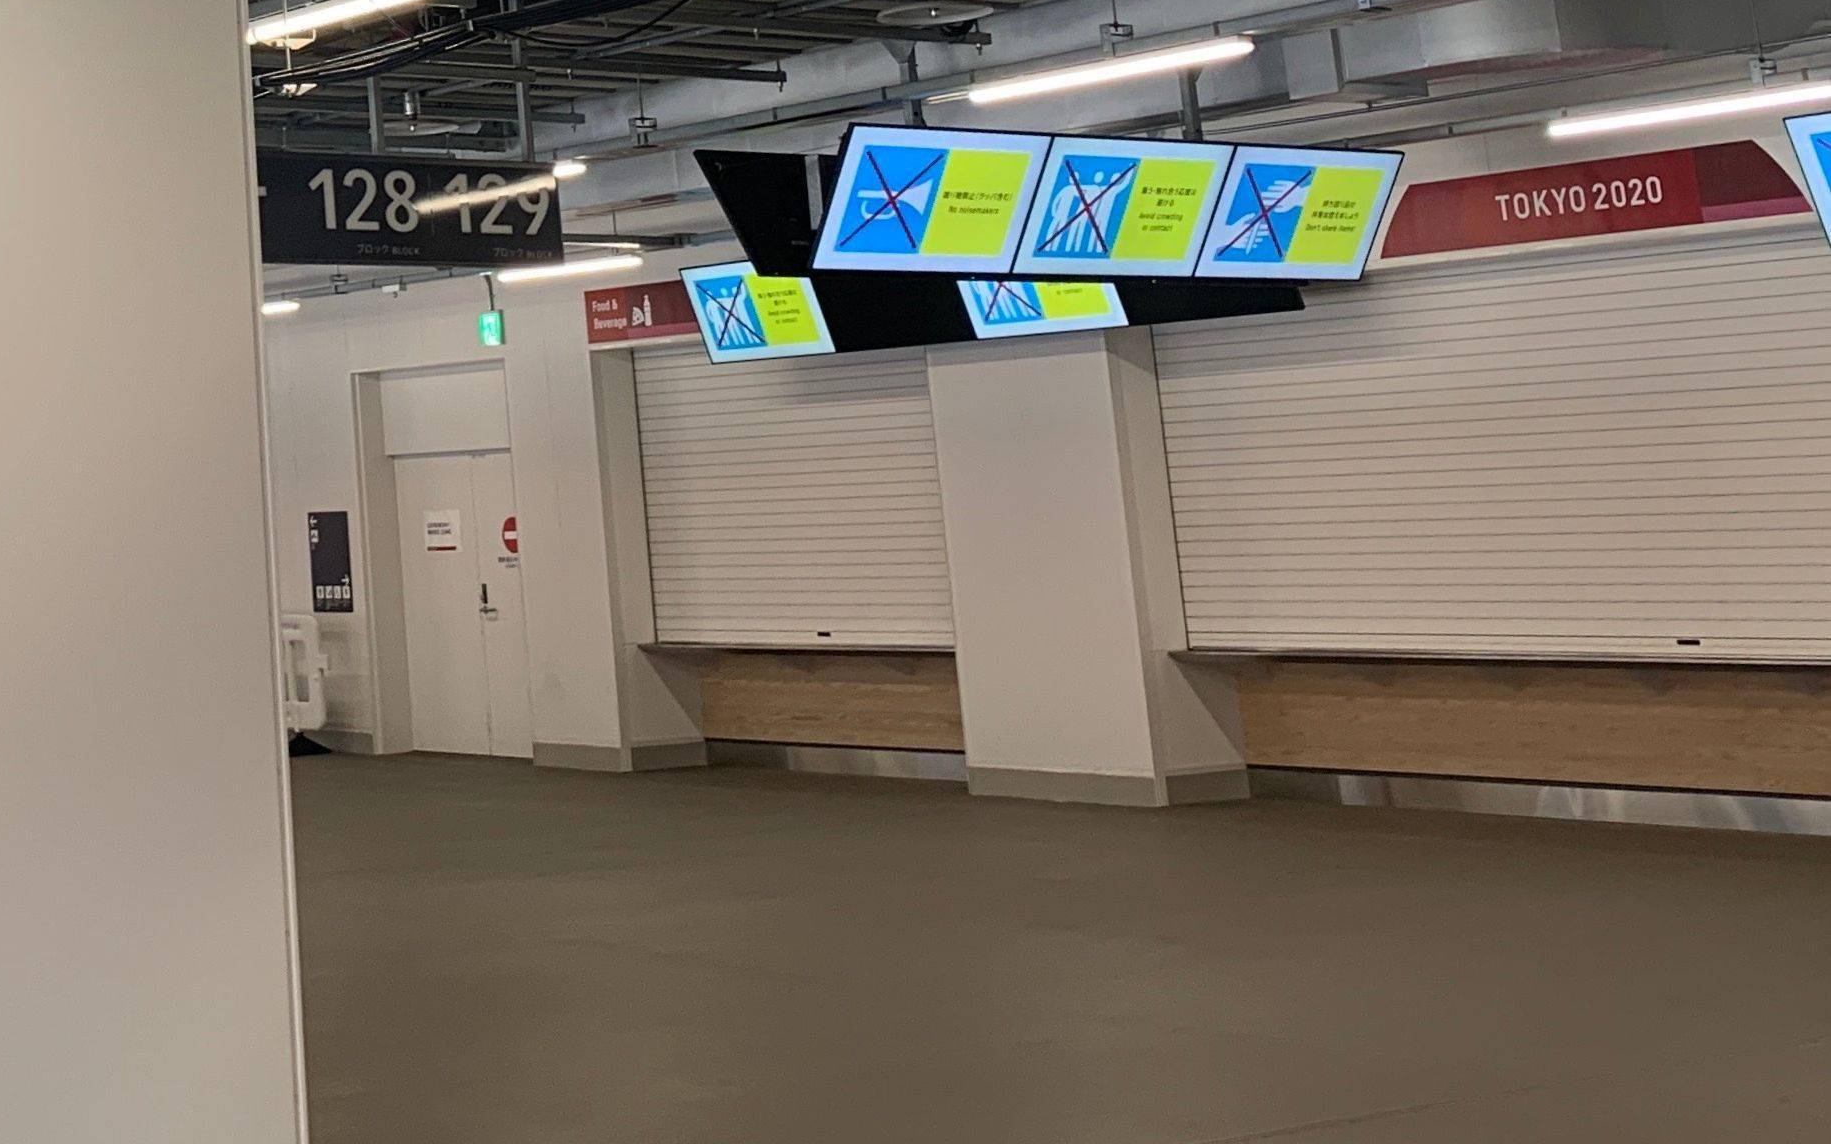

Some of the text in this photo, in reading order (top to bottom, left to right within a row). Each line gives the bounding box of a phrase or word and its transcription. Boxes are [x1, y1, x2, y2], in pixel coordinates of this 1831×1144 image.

[308, 168, 550, 236] 128 129
[1495, 175, 1663, 221] TOKYO 2020
[592, 298, 619, 312] Food &
[593, 317, 628, 329] Beverage
